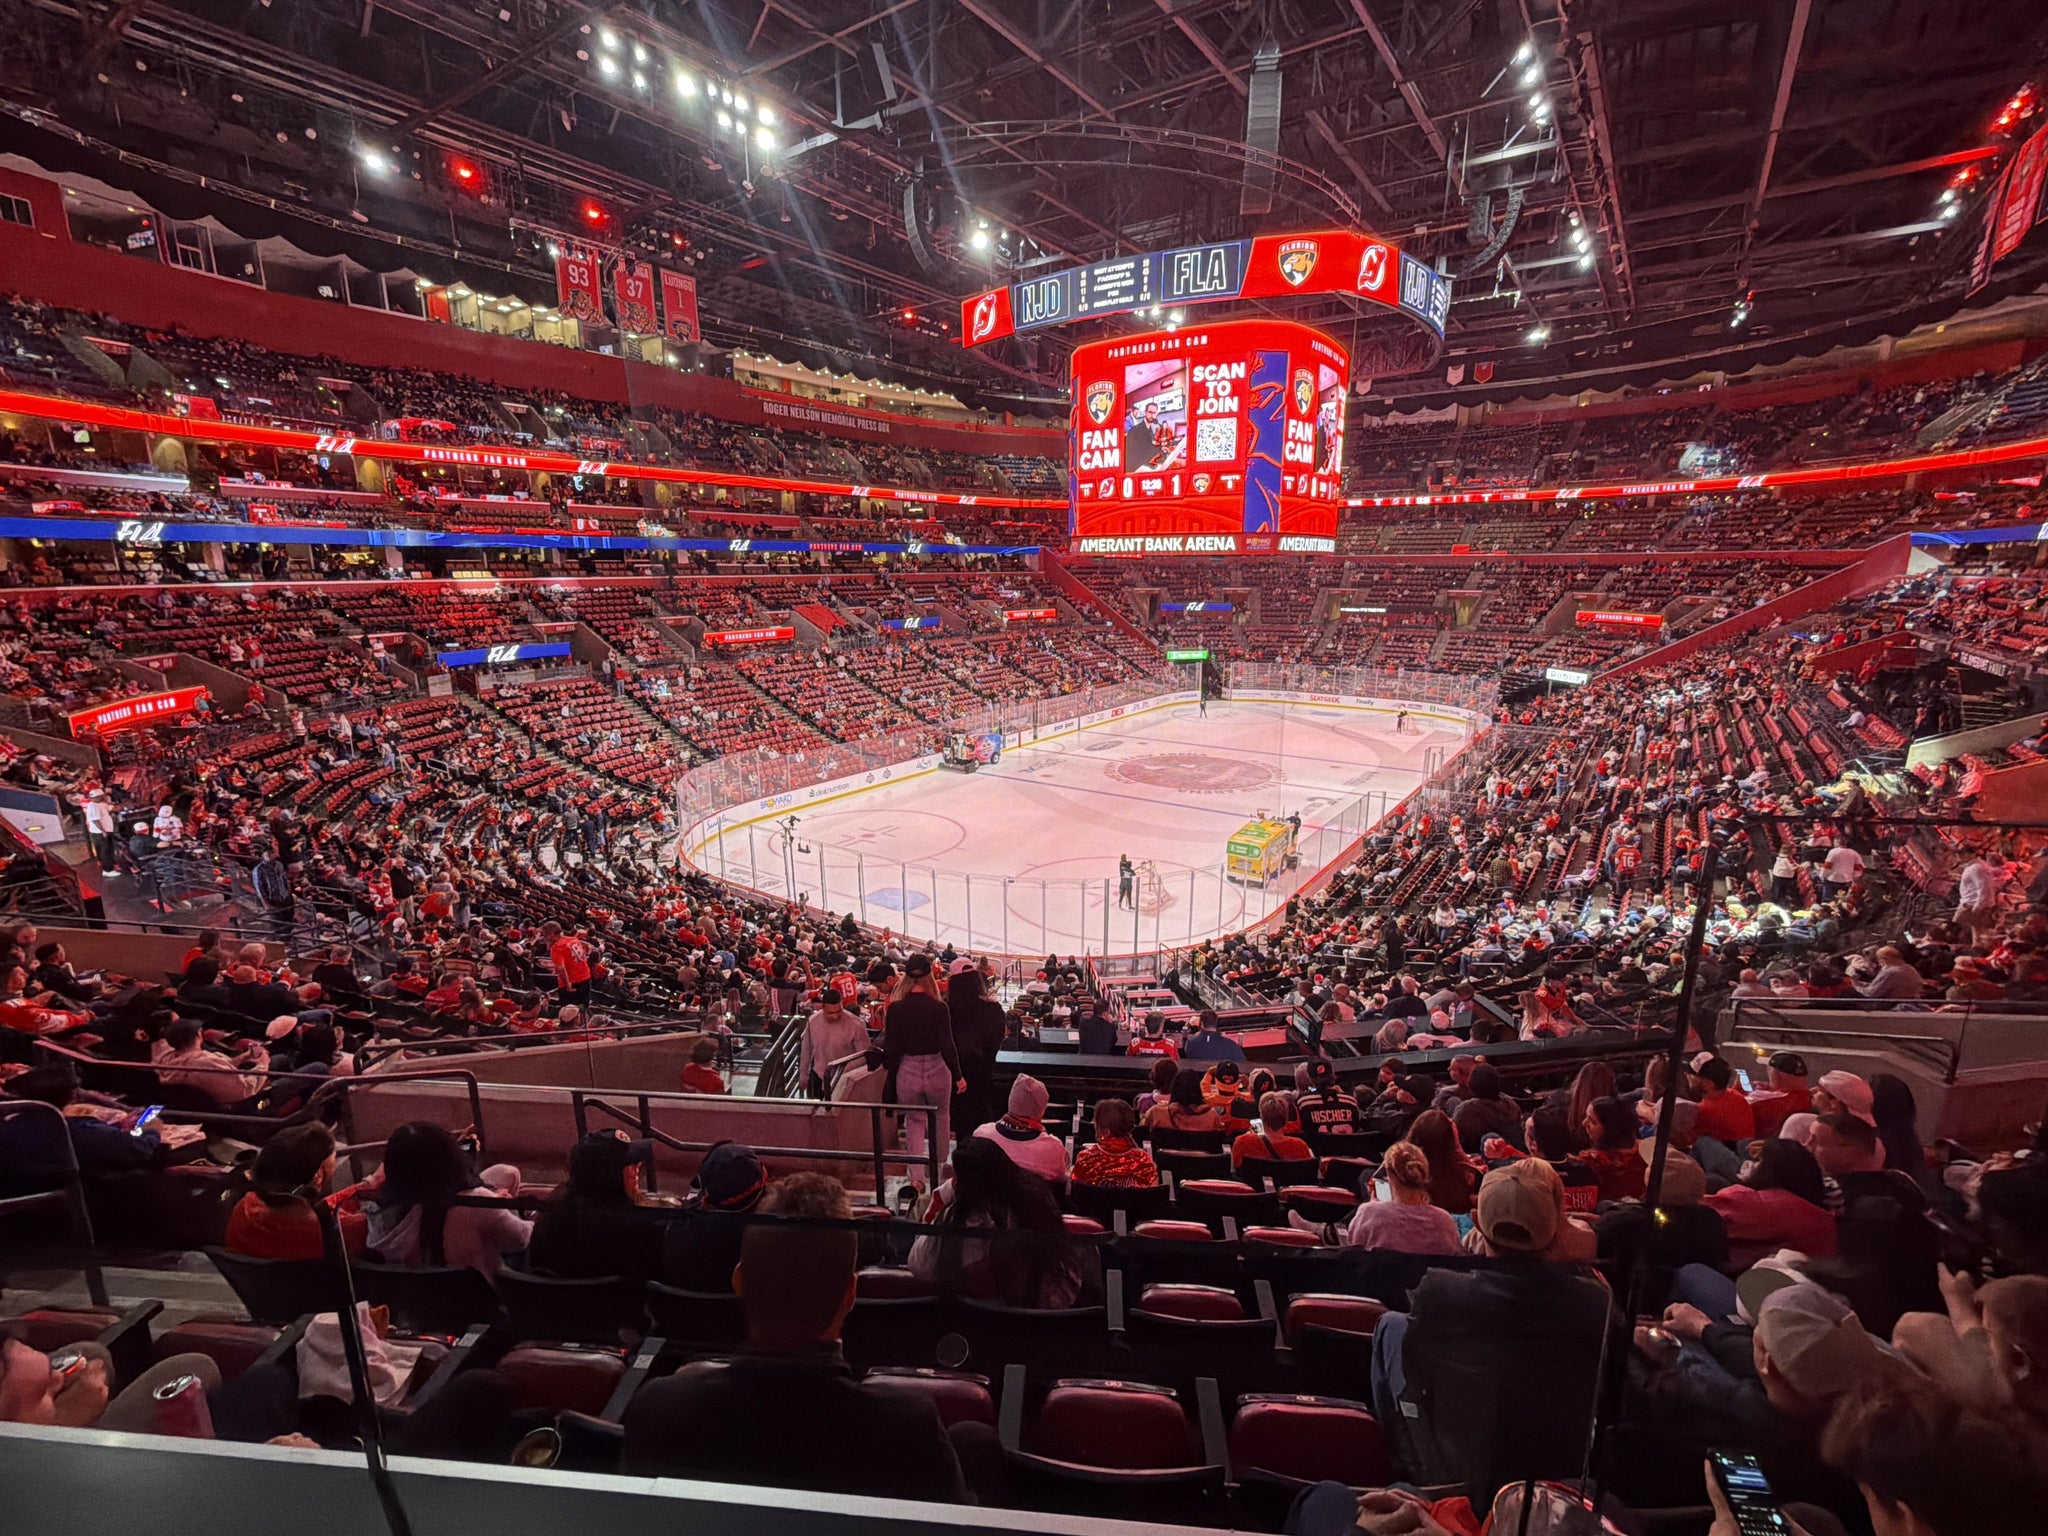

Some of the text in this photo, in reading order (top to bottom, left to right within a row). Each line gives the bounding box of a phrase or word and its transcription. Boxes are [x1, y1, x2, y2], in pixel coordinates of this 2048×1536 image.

[568, 264, 589, 287] 93
[1174, 249, 1227, 295] FLA
[626, 279, 643, 298] 37
[664, 275, 693, 292] LUONGO
[677, 291, 684, 309] 1
[1022, 279, 1061, 323] NJD
[1161, 338, 1180, 350] FAN
[1186, 335, 1208, 347] CAM
[1193, 362, 1246, 382] SCAN
[1205, 380, 1231, 397] TO
[1196, 397, 1239, 415] JOIN
[763, 401, 890, 433] ROGER NEILSON MEMORIAL PRESS BOX
[1082, 428, 1118, 450] FAN
[1288, 419, 1314, 442] FAN
[316, 435, 355, 453] FLA
[1285, 441, 1313, 464] CAM
[484, 454, 502, 464] FAN
[507, 456, 527, 466] CAM
[1080, 449, 1120, 470] CAM
[1123, 477, 1133, 498] 0
[1172, 475, 1181, 496] 1
[1662, 483, 1676, 492] FAN
[1679, 482, 1695, 491] CAM
[117, 521, 164, 542] FLA
[730, 539, 750, 551] FLA
[1080, 538, 1145, 553] AMERANT
[1145, 537, 1183, 551] BANK
[1185, 536, 1236, 551] ARENA
[904, 618, 920, 629] FLA
[488, 645, 520, 663] FLA
[135, 702, 154, 714] FAN
[157, 697, 176, 709] CAM
[1309, 694, 1340, 703] SEATGEEK
[1111, 707, 1125, 717] DEX
[1623, 855, 1634, 868] 16
[841, 981, 854, 998] 19
[1310, 1109, 1353, 1123] HISCHIER
